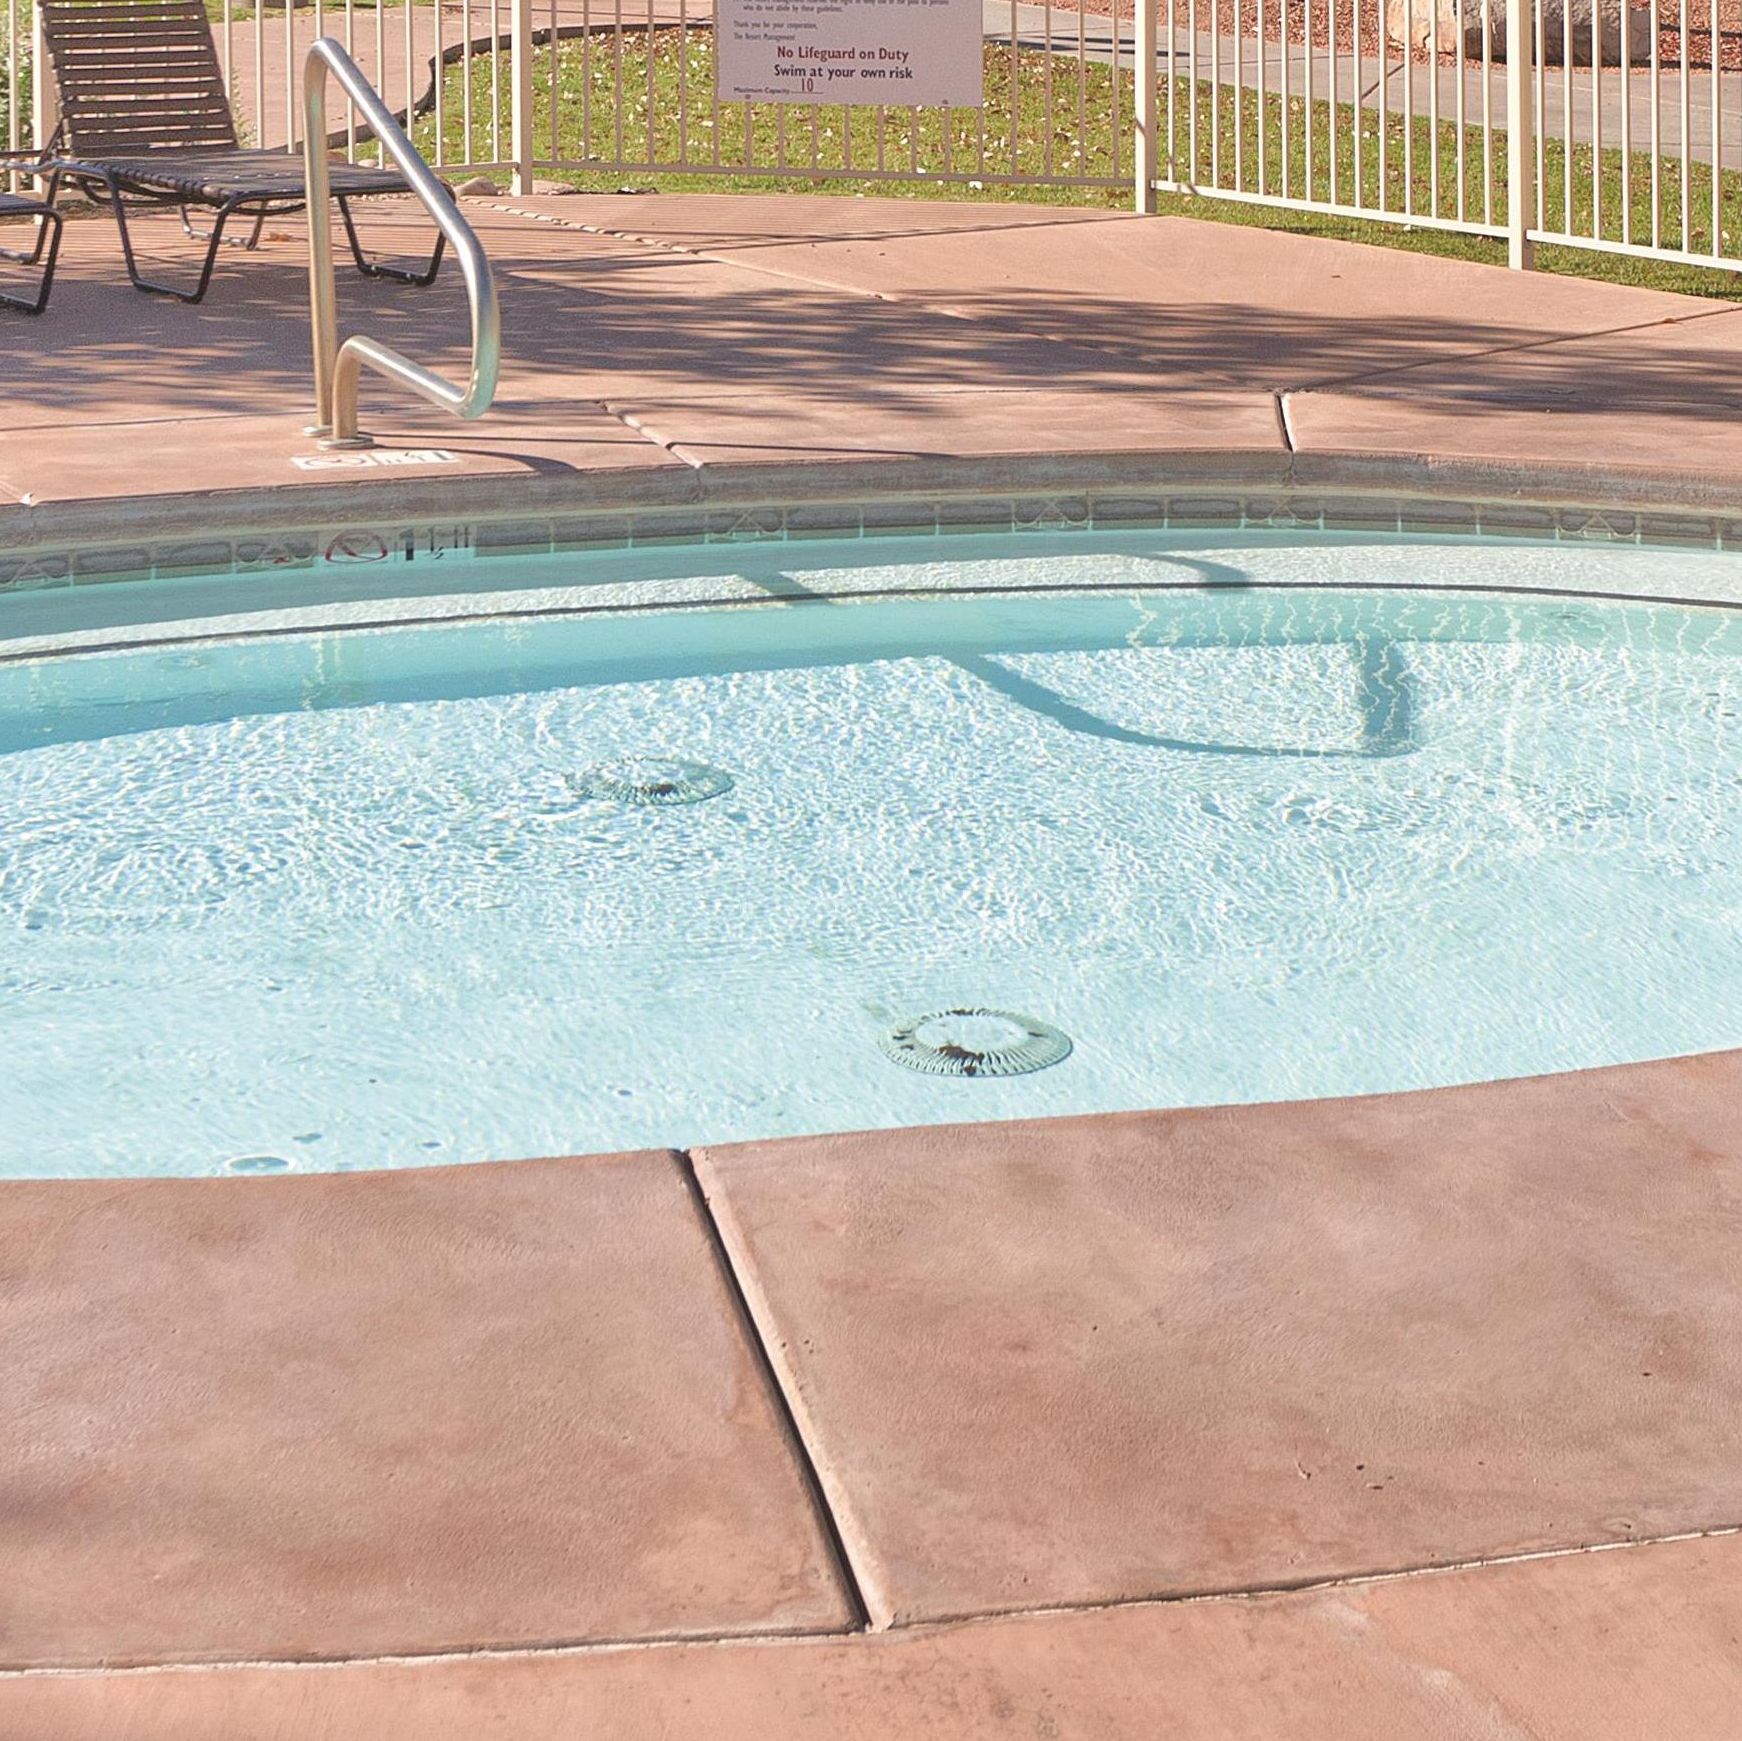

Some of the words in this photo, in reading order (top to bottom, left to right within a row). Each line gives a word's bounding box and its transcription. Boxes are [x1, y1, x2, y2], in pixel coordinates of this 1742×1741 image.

[777, 47, 793, 58] No
[798, 47, 855, 62] Lifeguard
[859, 51, 875, 59] on
[879, 49, 908, 64] Duty
[774, 65, 806, 77] Swim
[809, 65, 823, 77] at
[828, 69, 855, 81] your
[861, 69, 886, 77] own
[889, 66, 912, 78] risk
[801, 79, 814, 93] 10
